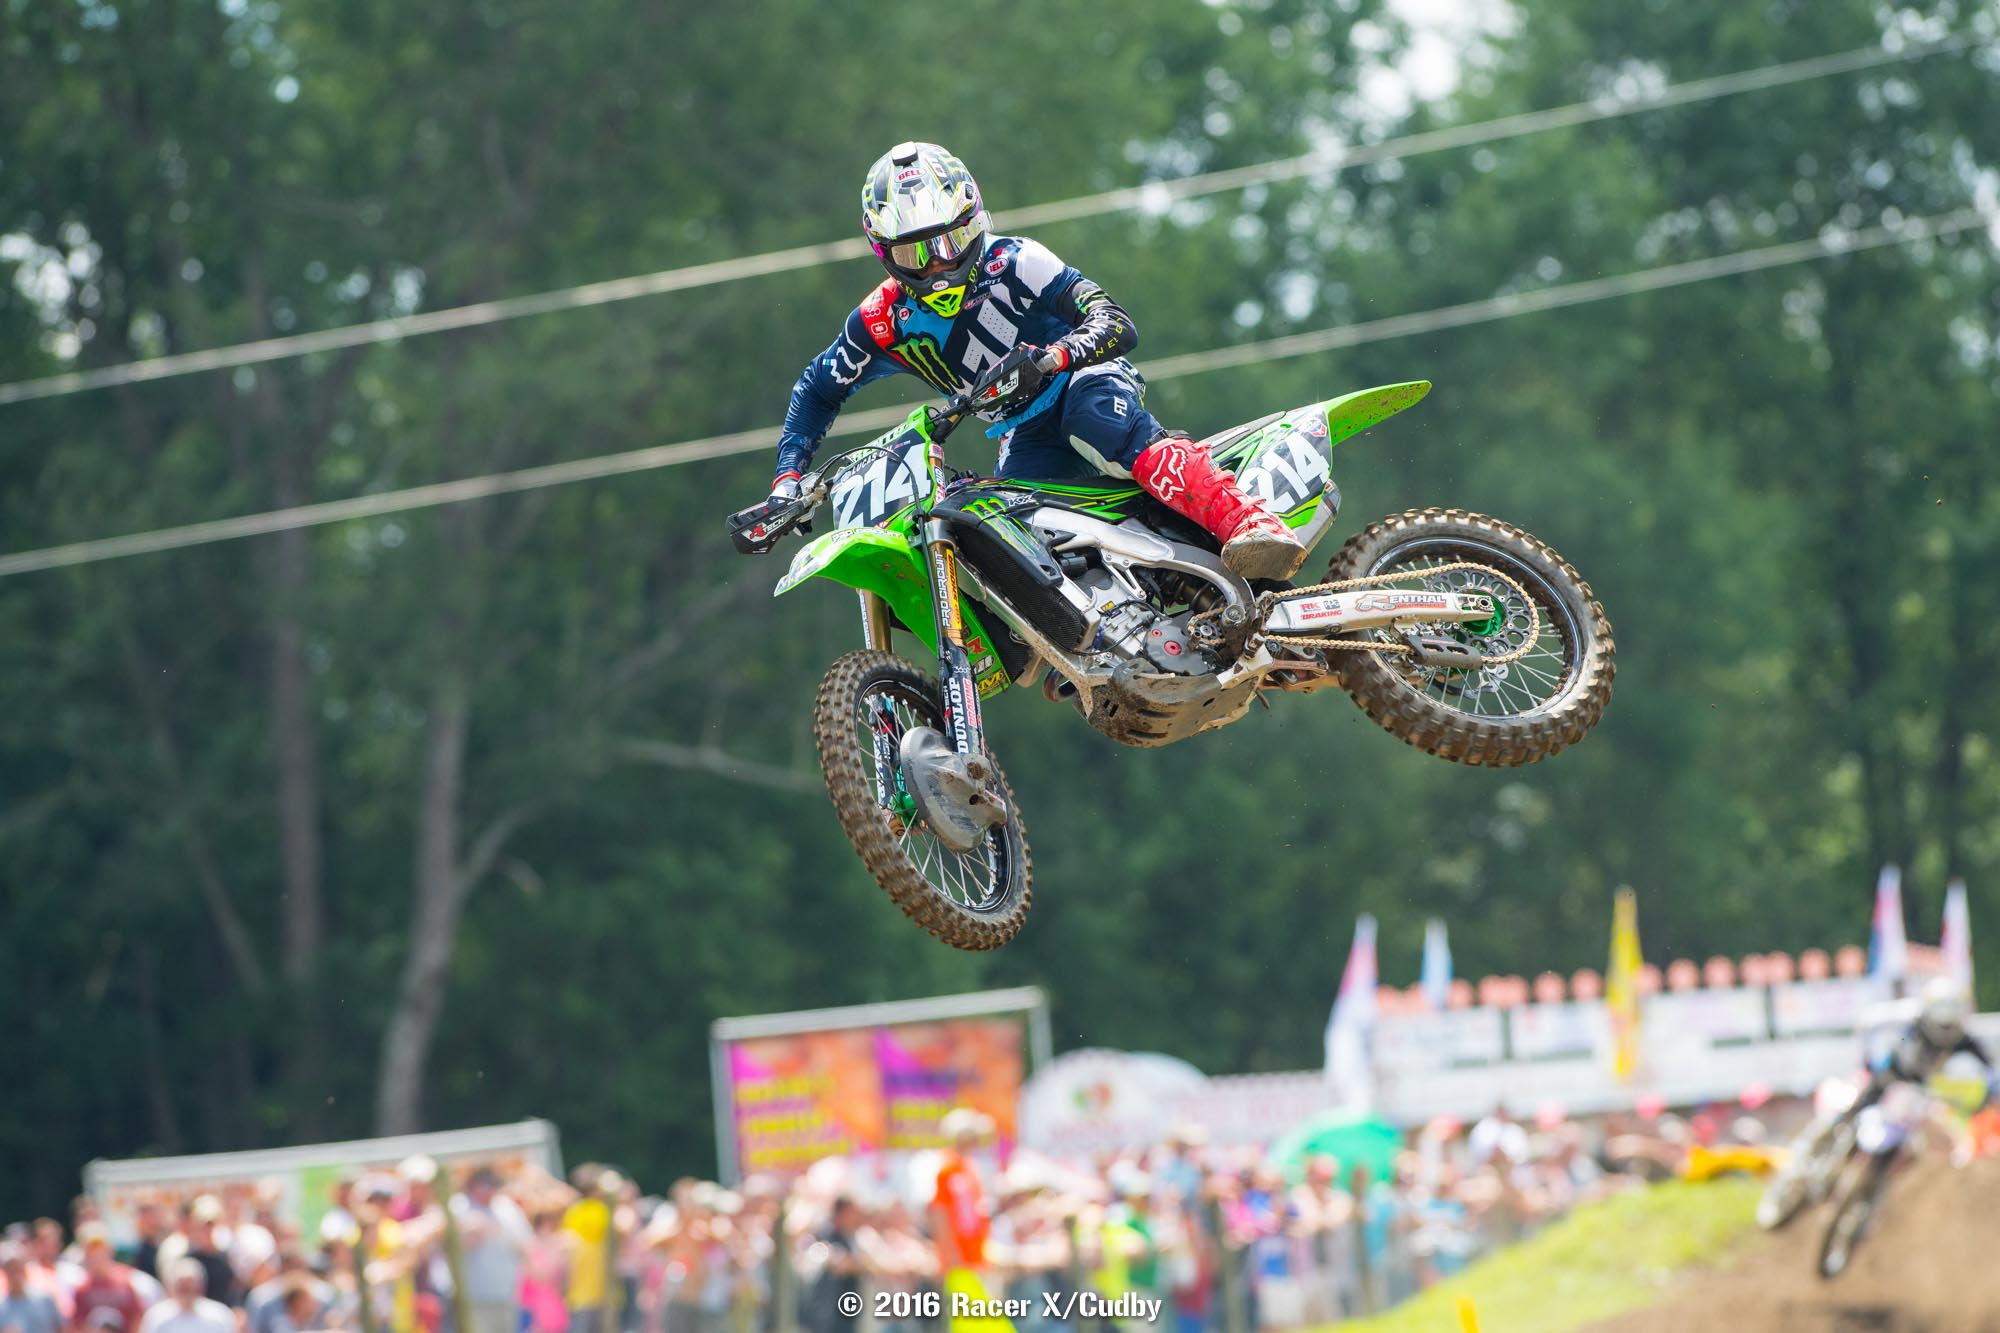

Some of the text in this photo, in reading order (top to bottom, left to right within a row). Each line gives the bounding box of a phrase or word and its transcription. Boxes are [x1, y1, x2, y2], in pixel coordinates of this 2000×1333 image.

[897, 169, 922, 181] BELL
[851, 450, 879, 476] LUCAS
[1234, 431, 1331, 513] 214
[830, 442, 932, 531] 214
[1008, 494, 1034, 507] KX
[934, 550, 952, 628] PRO CIRCUIT
[947, 554, 958, 602] SHOWA
[1300, 602, 1320, 610] RK
[1301, 609, 1343, 620] BRAKING
[949, 677, 969, 754] DUNLOP
